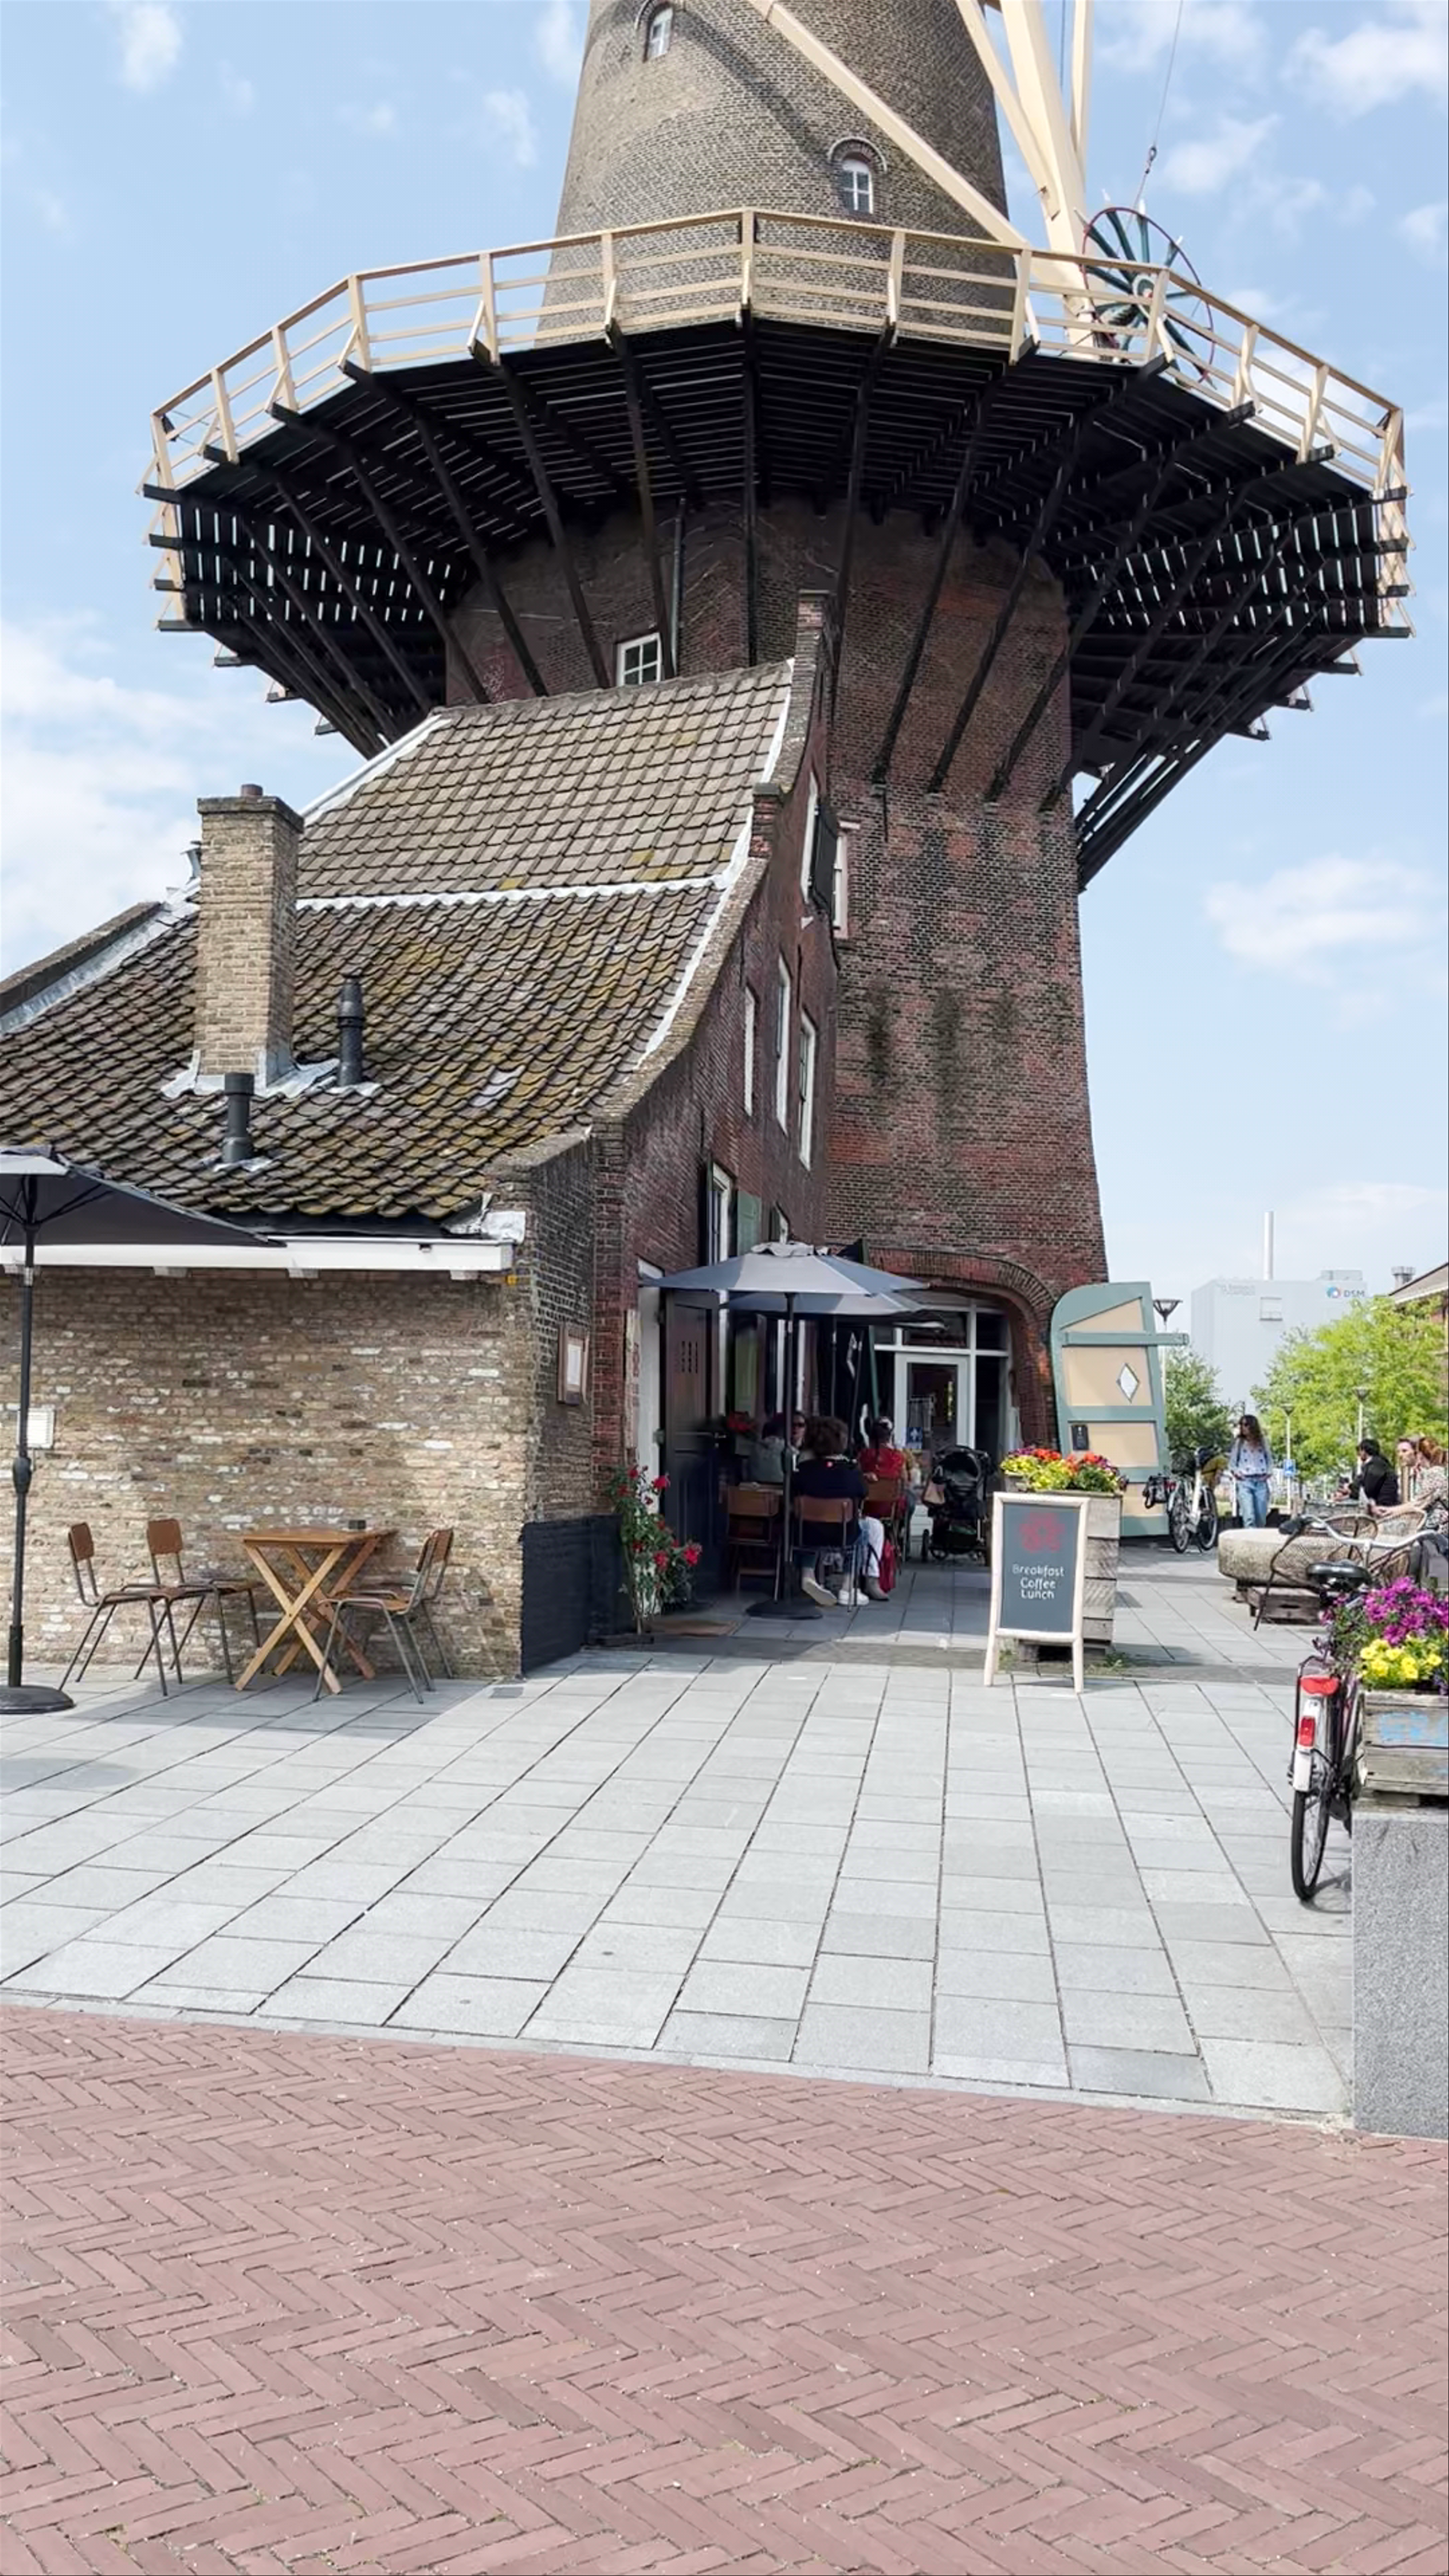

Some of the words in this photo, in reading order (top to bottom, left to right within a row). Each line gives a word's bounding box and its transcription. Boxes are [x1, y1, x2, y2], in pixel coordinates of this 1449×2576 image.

[1012, 1564, 1064, 1577] Breakfast
[1020, 1577, 1056, 1590] Coffee
[1021, 1589, 1054, 1600] Lunch
